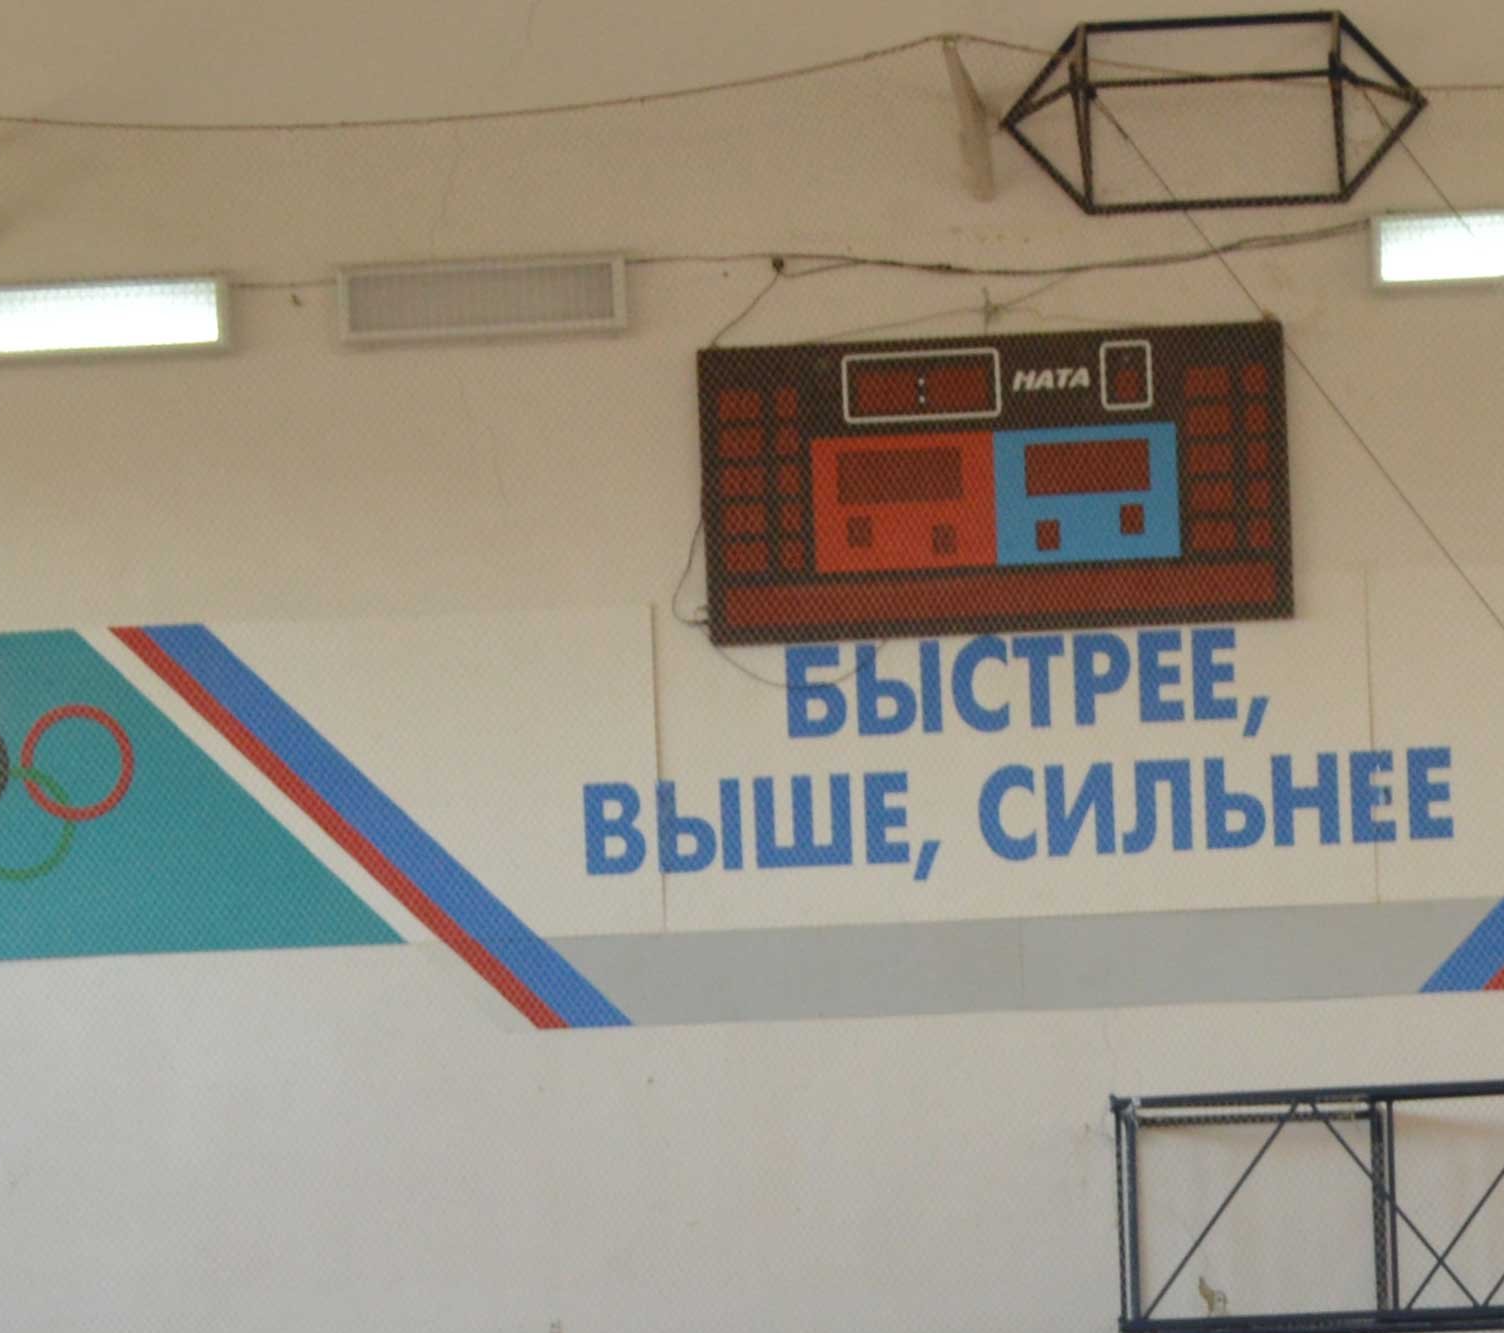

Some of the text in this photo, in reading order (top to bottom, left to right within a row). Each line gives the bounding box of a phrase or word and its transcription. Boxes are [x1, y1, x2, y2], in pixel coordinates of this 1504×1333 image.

[785, 628, 1269, 738] БЫСТРЕЕ,
[582, 747, 1453, 881] ВЫШЕ, СИЛЬНЕЕ
